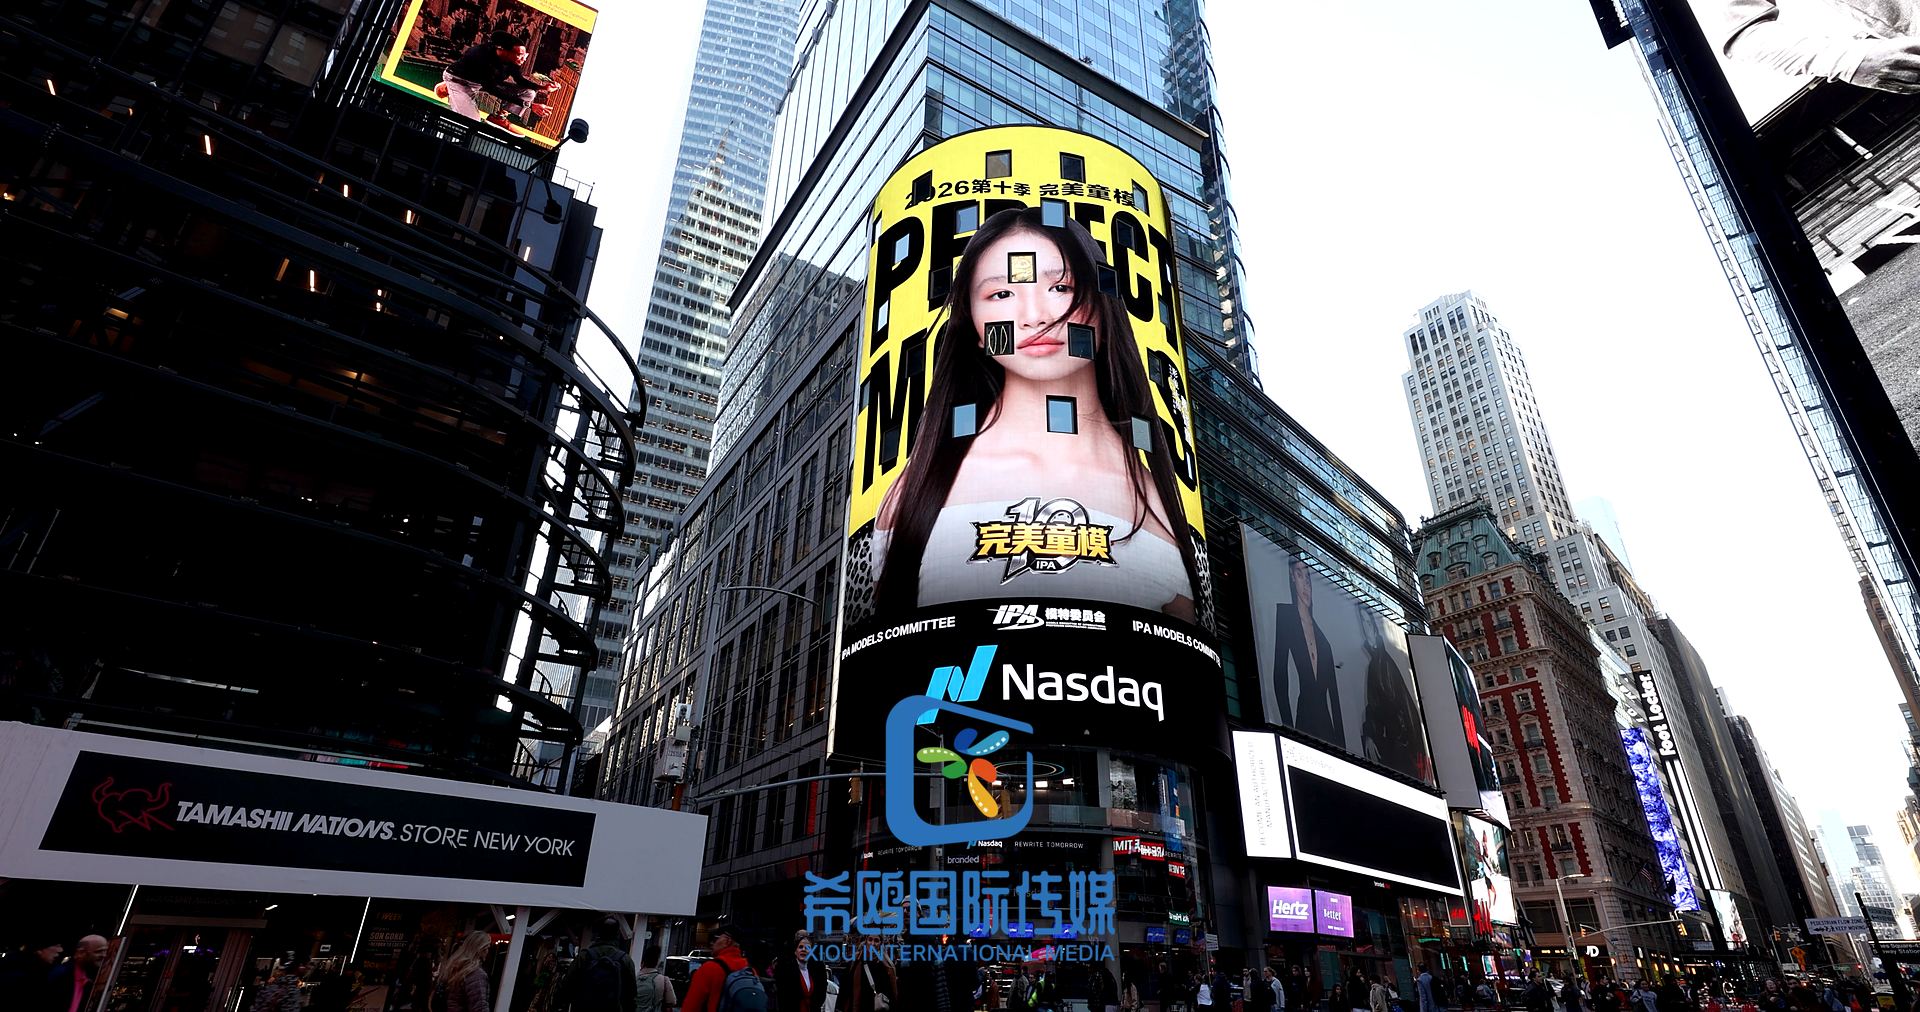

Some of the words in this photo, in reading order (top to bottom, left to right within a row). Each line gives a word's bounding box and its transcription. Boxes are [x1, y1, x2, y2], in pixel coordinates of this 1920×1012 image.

[977, 523, 1110, 559] 完美童模
[1036, 560, 1057, 570] IPA
[991, 604, 1041, 626] IPA
[851, 631, 884, 654] MODELS
[884, 616, 956, 640] COMMITTEE
[1132, 620, 1152, 635] IPA
[1153, 624, 1193, 647] MODELS
[1002, 663, 1165, 722] Nasdaq
[1638, 673, 1665, 722] Locker
[1653, 723, 1677, 757] Foot
[176, 800, 293, 832] TAMASHII
[400, 823, 468, 850] STORE
[473, 830, 521, 853] NEW
[524, 835, 576, 858] YORK
[947, 855, 980, 864] branded
[977, 840, 1003, 849] Nasdaq
[1046, 841, 1084, 849] TOMORROW
[1272, 899, 1309, 918] Hertz
